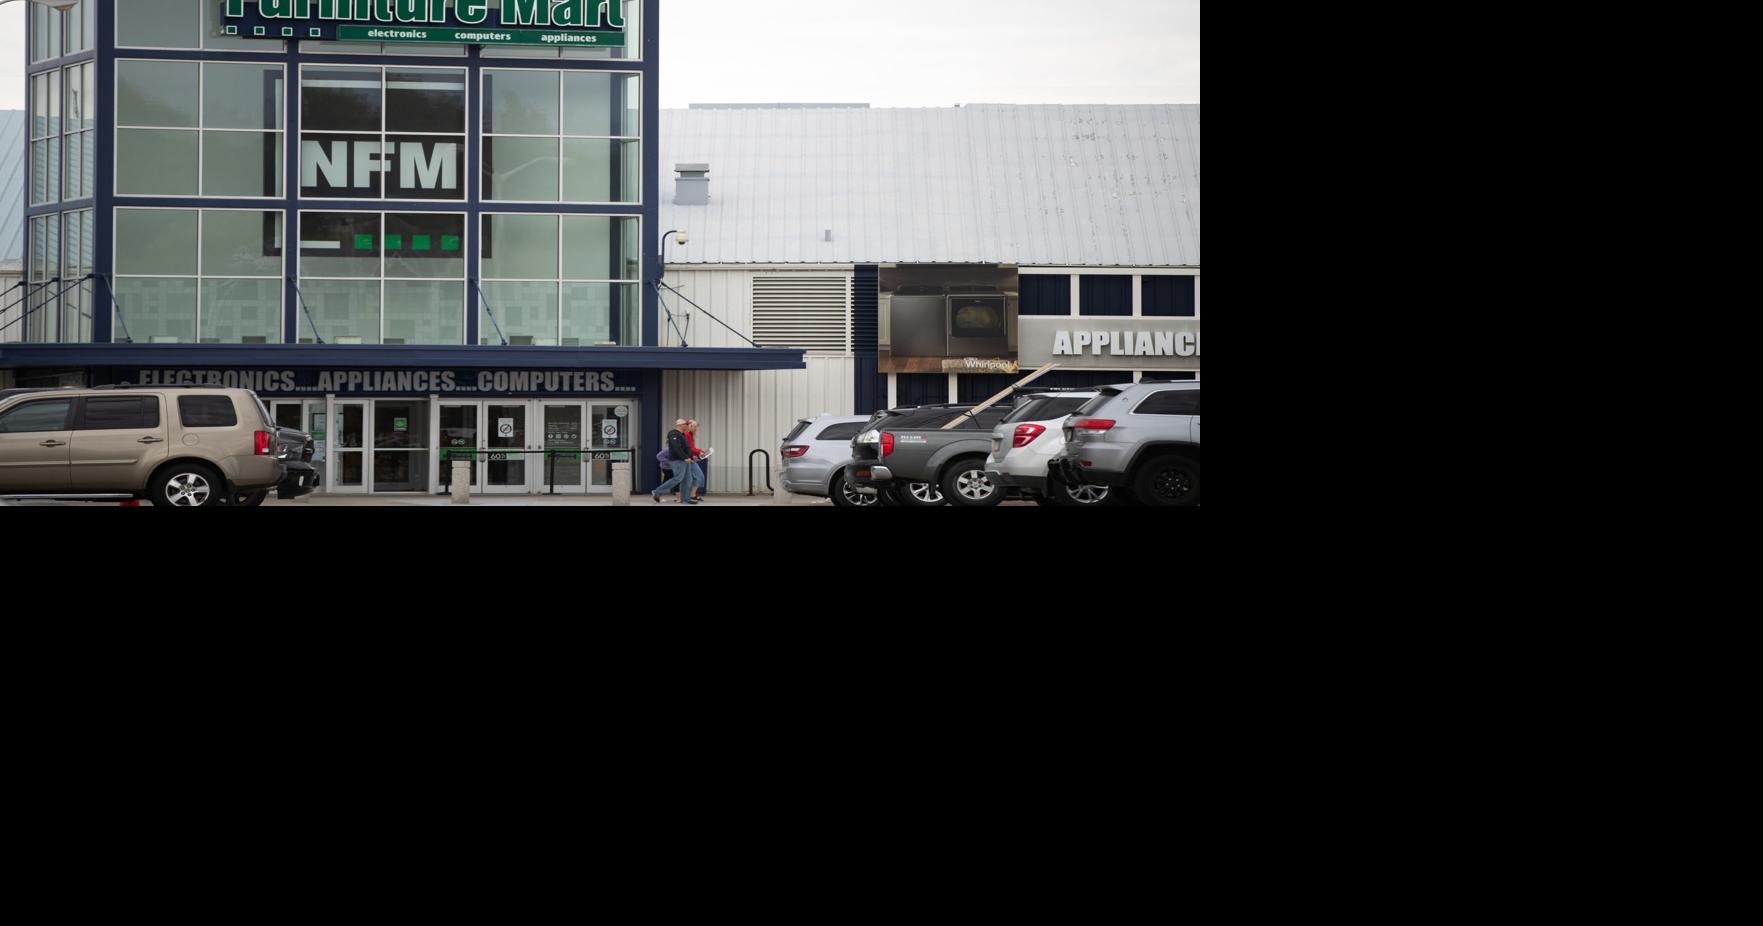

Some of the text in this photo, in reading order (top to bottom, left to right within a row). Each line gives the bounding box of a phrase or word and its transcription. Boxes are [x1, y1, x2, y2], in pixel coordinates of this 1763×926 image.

[501, 0, 625, 28] Mart
[367, 29, 597, 43] electronics computers appliances
[301, 140, 457, 190] NFM
[1052, 330, 1200, 356] APPLIANC
[965, 359, 1010, 369] Whirlpool
